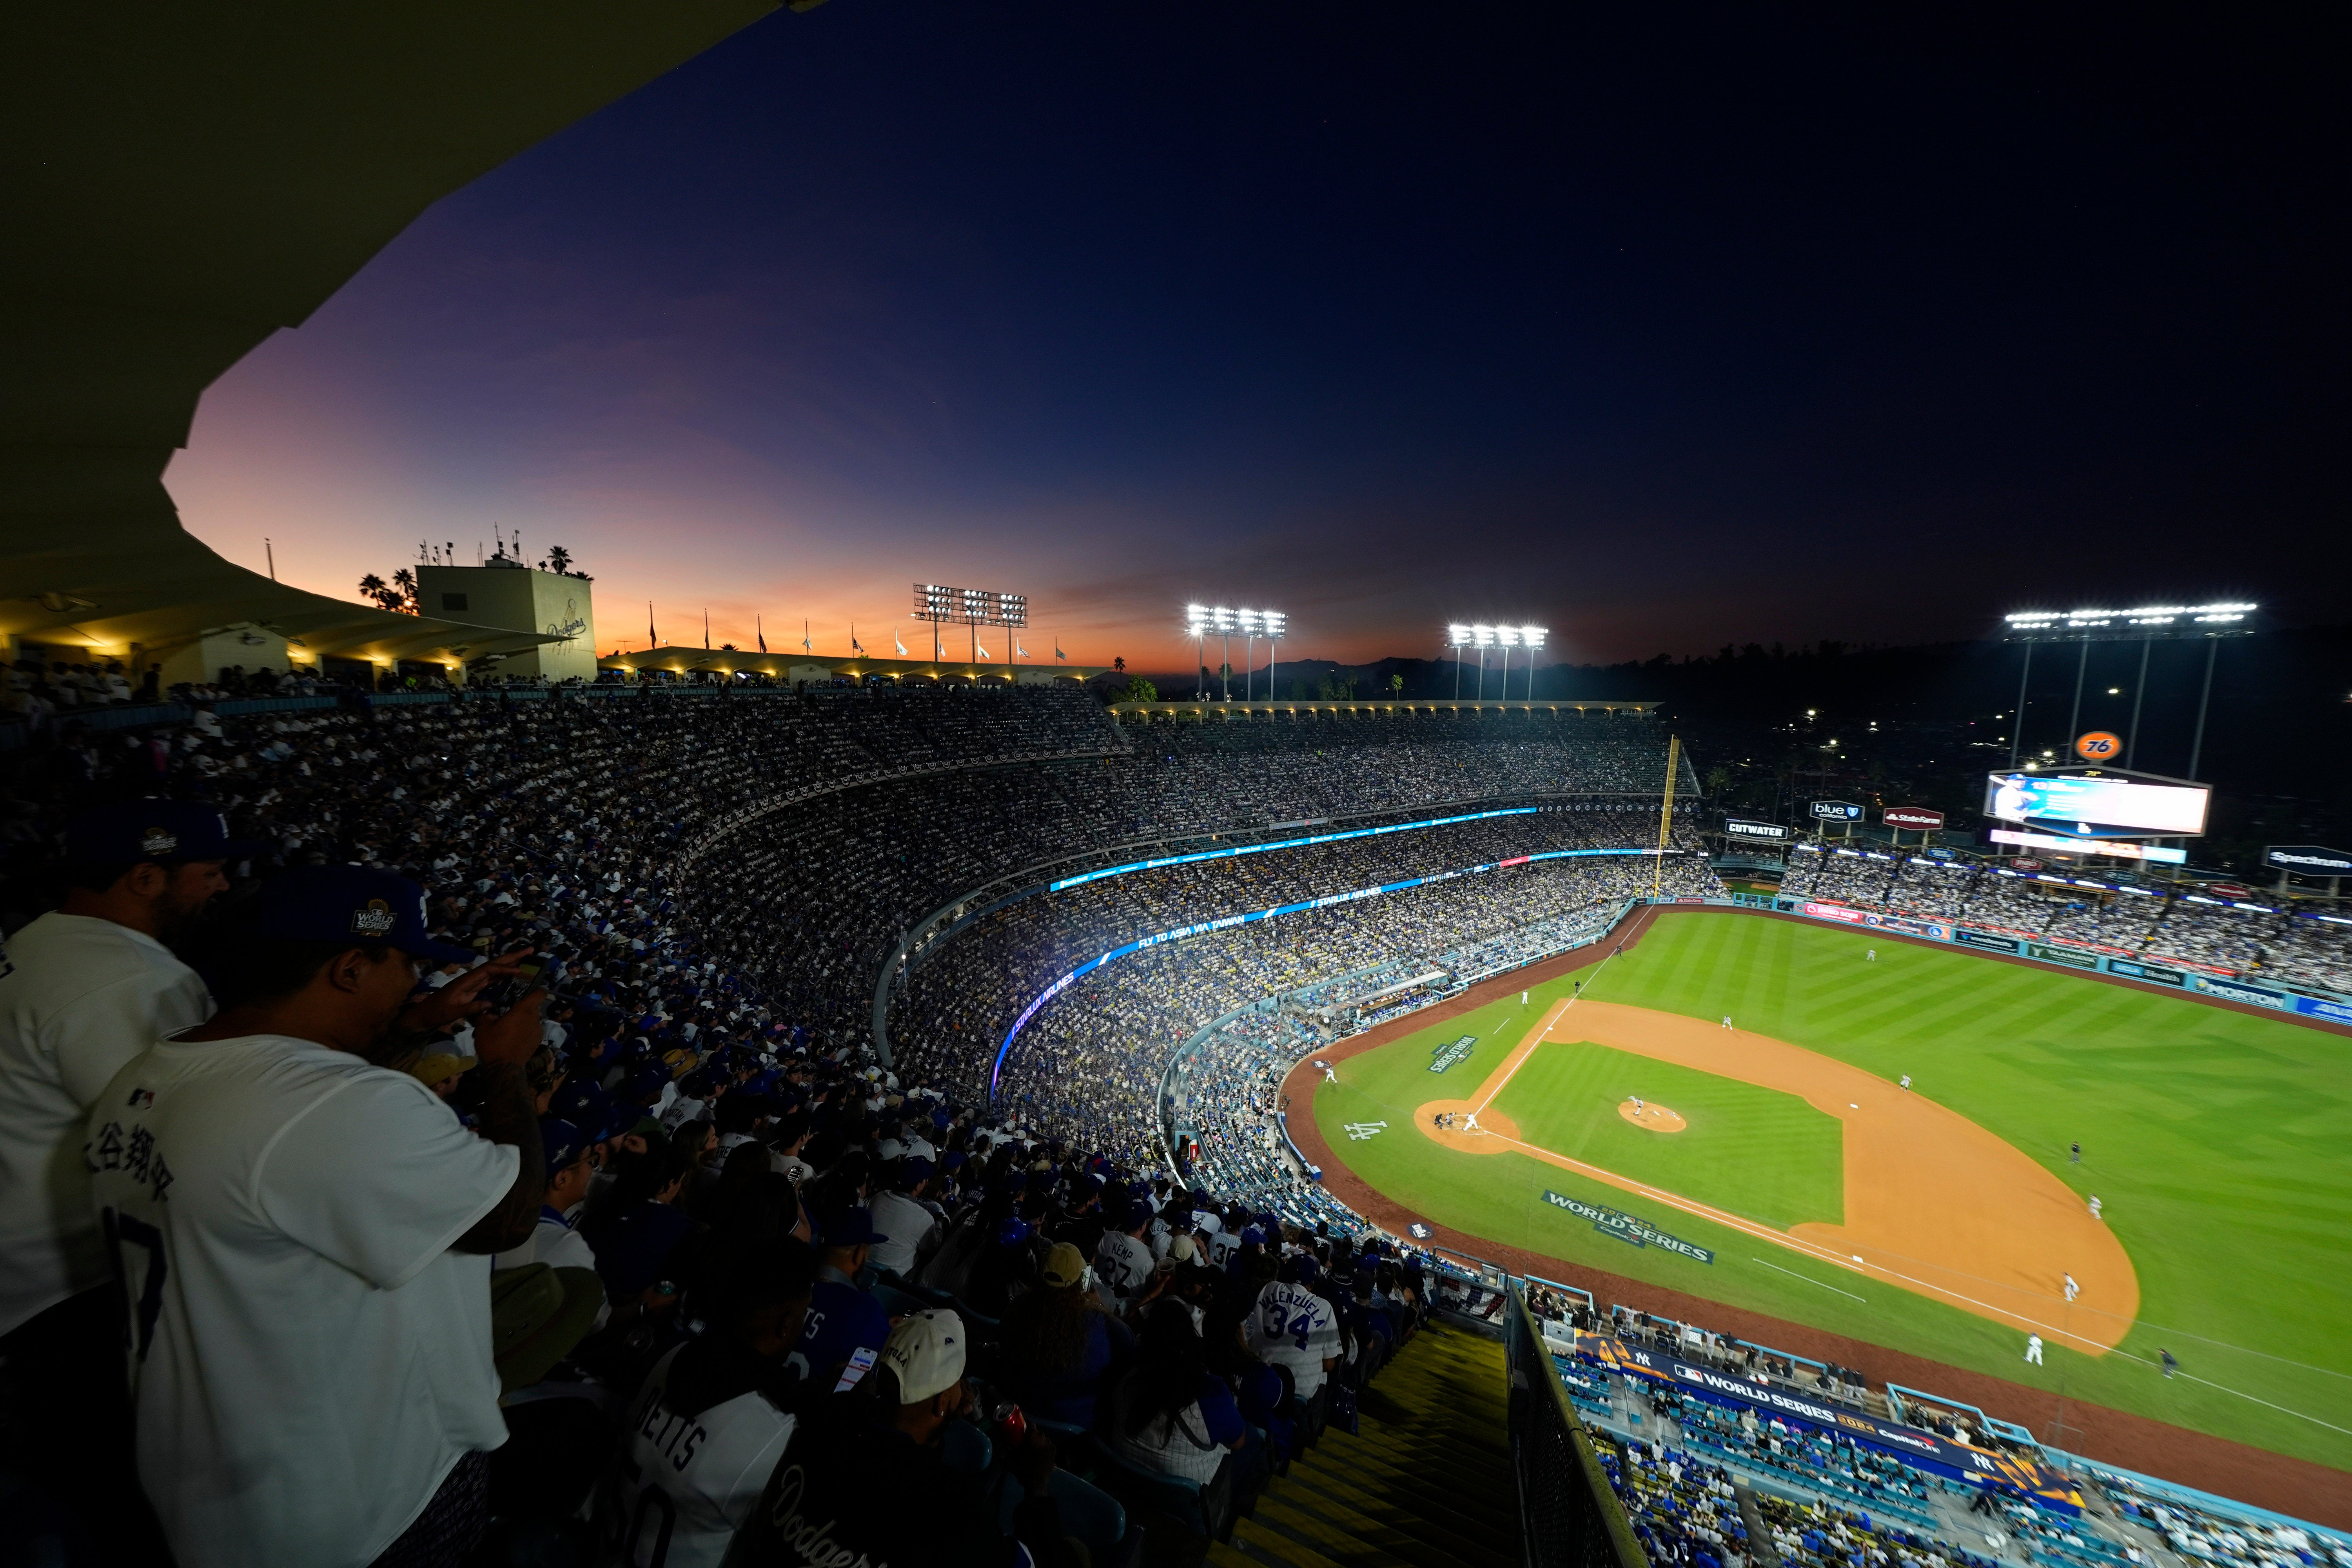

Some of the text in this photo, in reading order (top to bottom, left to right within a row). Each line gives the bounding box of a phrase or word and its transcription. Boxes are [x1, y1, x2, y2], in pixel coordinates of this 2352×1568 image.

[2083, 739, 2112, 753] 76
[1815, 804, 1845, 815] blue
[1729, 823, 1782, 837] CUTWATER
[2270, 851, 2348, 868] Spectrum
[1317, 886, 1381, 907] STARLUX AIRLINES
[358, 913, 394, 923] WORLD
[1817, 907, 1840, 916] JINRO
[1840, 911, 1858, 920] SOJU
[356, 921, 391, 930] SERIES
[1139, 915, 1245, 948] FLY TO ASIA VIA TAIWAN
[2145, 970, 2180, 982] Health
[1016, 972, 1074, 1032] STARLUX AIRLINES
[2208, 984, 2285, 1008] MORTON
[1449, 1036, 1475, 1055] WORLD
[1430, 1053, 1456, 1072] SERIES
[1343, 1120, 1389, 1140] LA
[1549, 1192, 1708, 1262] WORLD SERIES
[1112, 1242, 1133, 1260] KEMP
[1103, 1256, 1132, 1287] 27
[1258, 1291, 1326, 1328] VALENZUELA
[1263, 1303, 1311, 1351] 34
[1704, 1373, 1770, 1402] WORLD
[1771, 1394, 1836, 1423] SERIES
[633, 1386, 706, 1472] BETTS
[772, 1464, 887, 1568] Dodger
